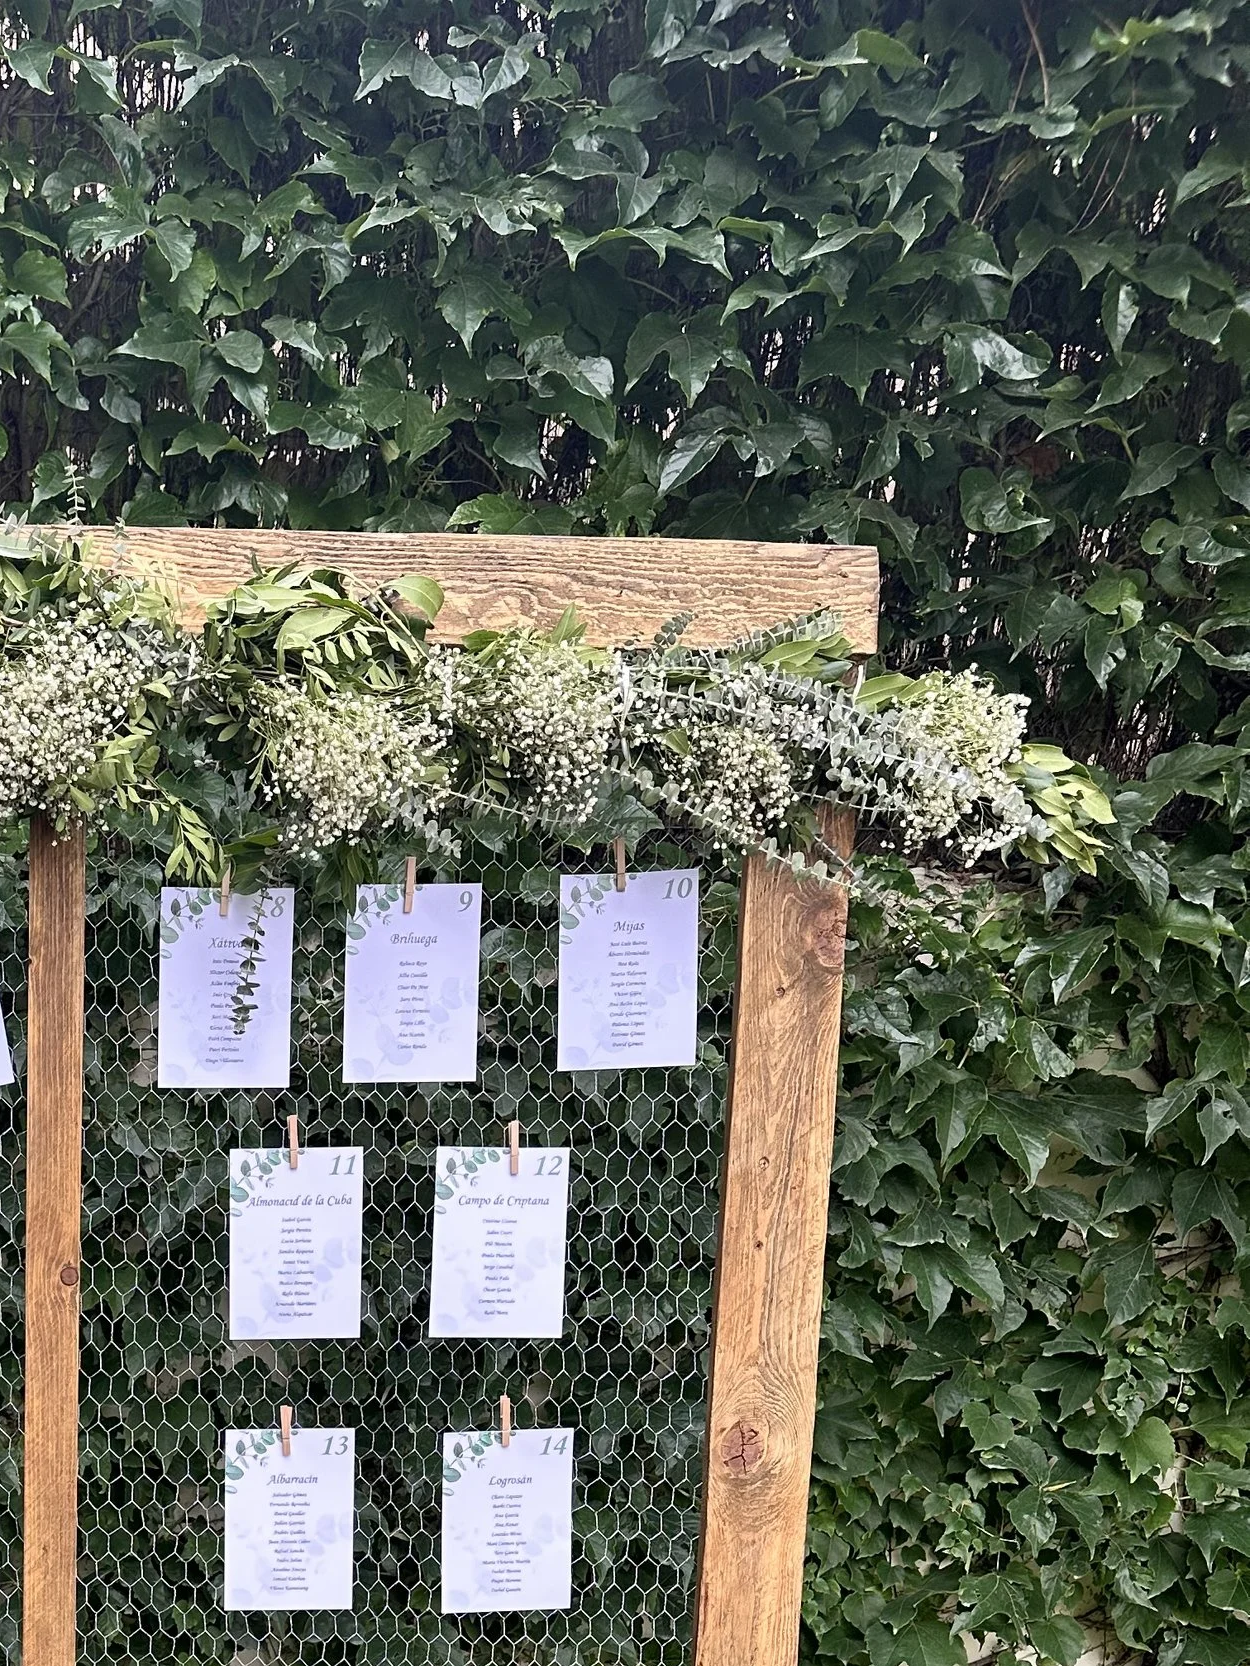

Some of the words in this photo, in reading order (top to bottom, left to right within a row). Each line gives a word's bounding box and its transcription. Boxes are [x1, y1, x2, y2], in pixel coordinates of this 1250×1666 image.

[661, 876, 694, 900] 10
[270, 895, 286, 918] 8
[458, 890, 473, 913] 9
[613, 920, 646, 935] Mijas
[389, 931, 438, 948] Brihuega
[328, 1154, 357, 1176] 11
[533, 1155, 564, 1177] 12
[246, 1195, 300, 1208] Almonacid
[301, 1194, 313, 1207] de
[315, 1194, 325, 1206] la
[326, 1194, 353, 1207] Cuba
[458, 1195, 491, 1209] Campo
[493, 1194, 505, 1206] de
[506, 1194, 550, 1209] Criptana
[321, 1435, 349, 1456] 13
[539, 1435, 570, 1456] 14
[265, 1473, 318, 1486] Albarracín
[488, 1475, 533, 1488] Logrosán
